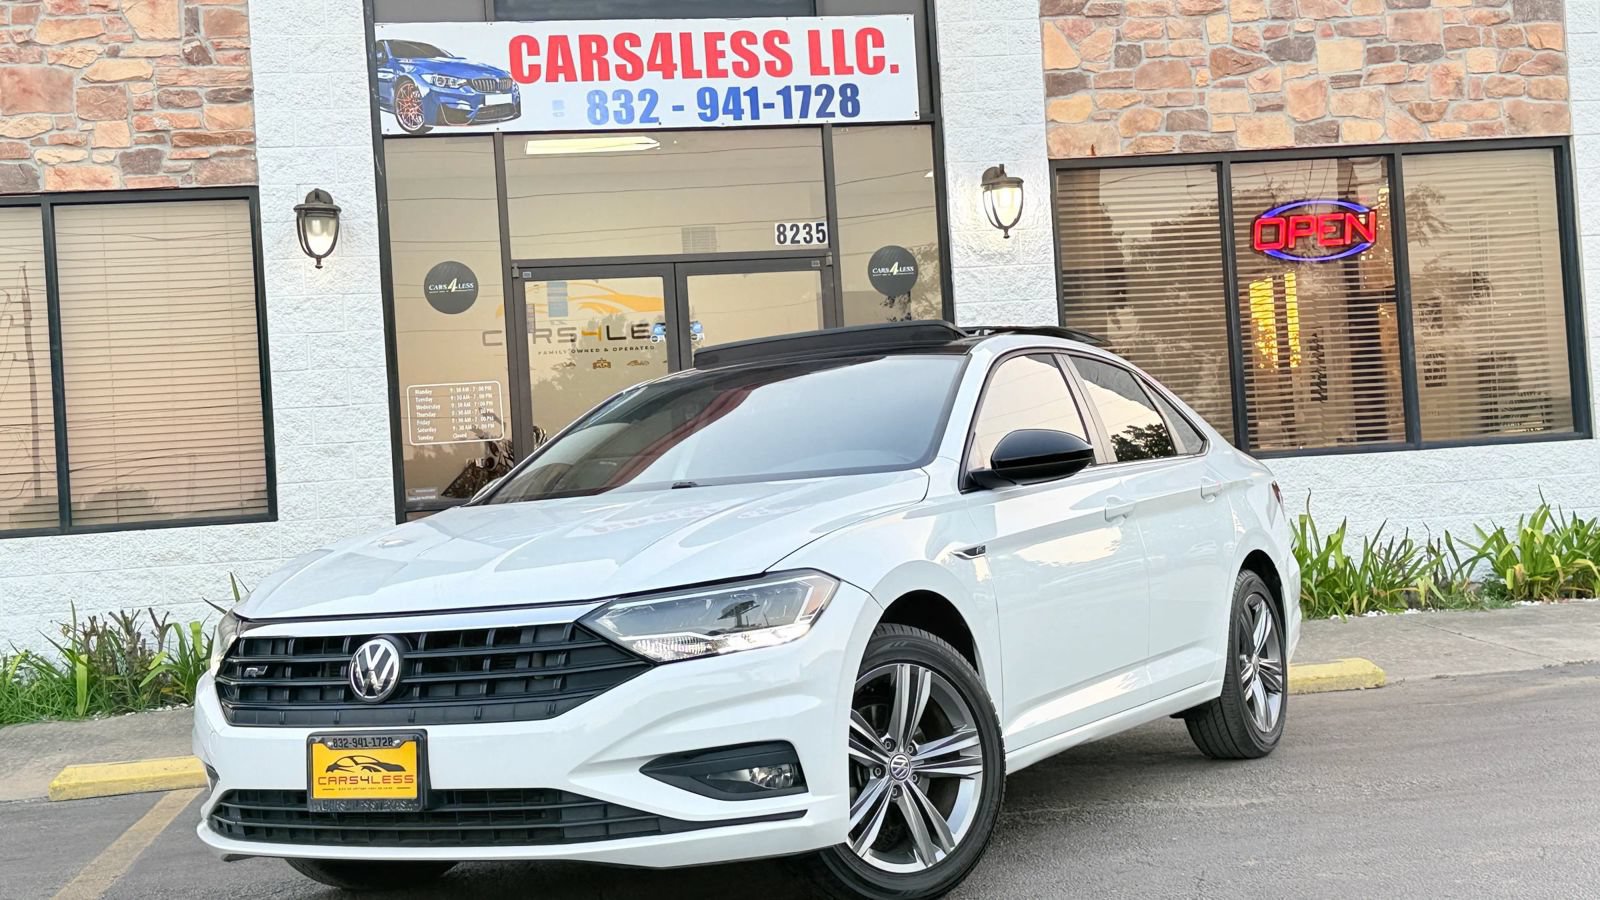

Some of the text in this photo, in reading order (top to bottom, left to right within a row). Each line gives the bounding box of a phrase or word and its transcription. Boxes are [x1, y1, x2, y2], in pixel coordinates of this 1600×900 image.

[508, 27, 900, 84] CARS4LESS LLC.
[586, 88, 660, 125] 832
[698, 83, 861, 122] 941-1728
[776, 222, 827, 245] 8235
[1253, 211, 1377, 251] OPEN
[318, 774, 414, 786] CARS4LESS
